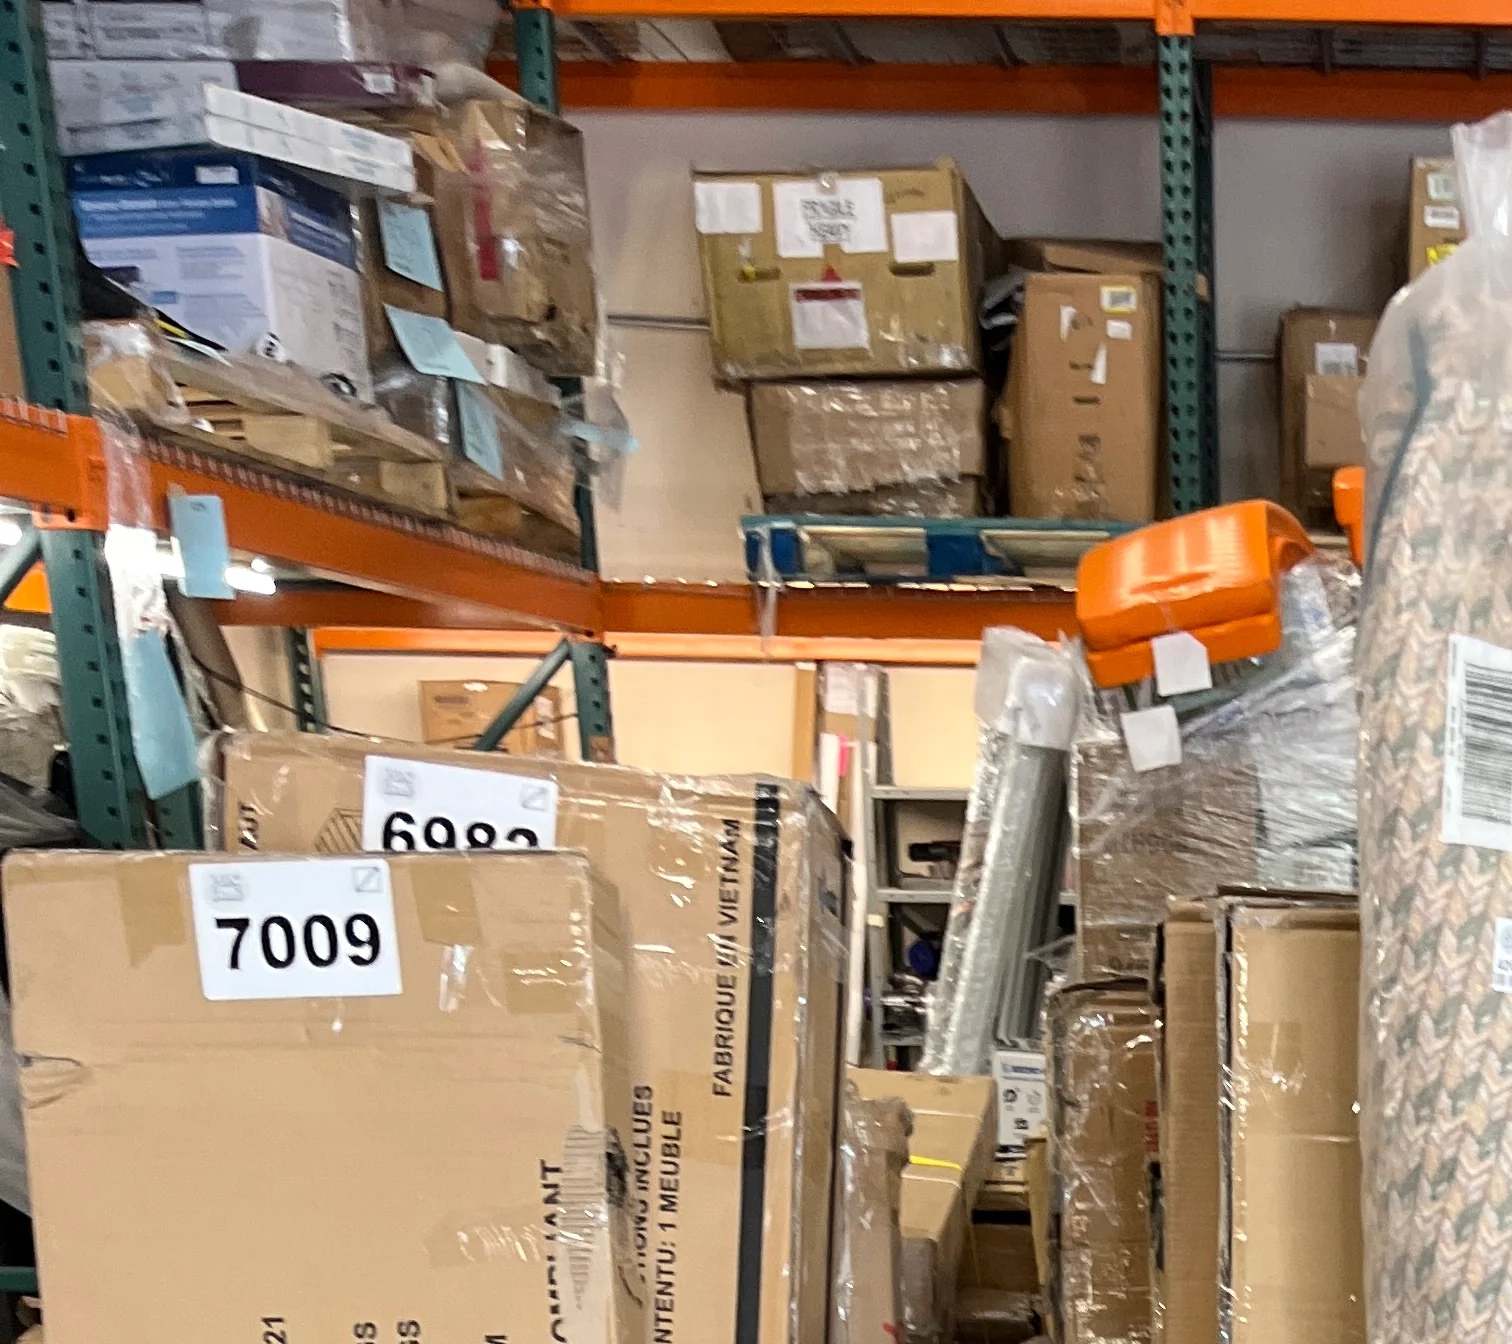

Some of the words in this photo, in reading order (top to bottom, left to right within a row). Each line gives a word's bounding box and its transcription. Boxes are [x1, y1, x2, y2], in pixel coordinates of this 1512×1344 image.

[717, 819, 742, 926] VIETNAM
[214, 913, 381, 970] 7009
[712, 975, 737, 1097] FABRIQUE
[658, 1111, 682, 1214] MEUBLE
[658, 1222, 676, 1232] 1
